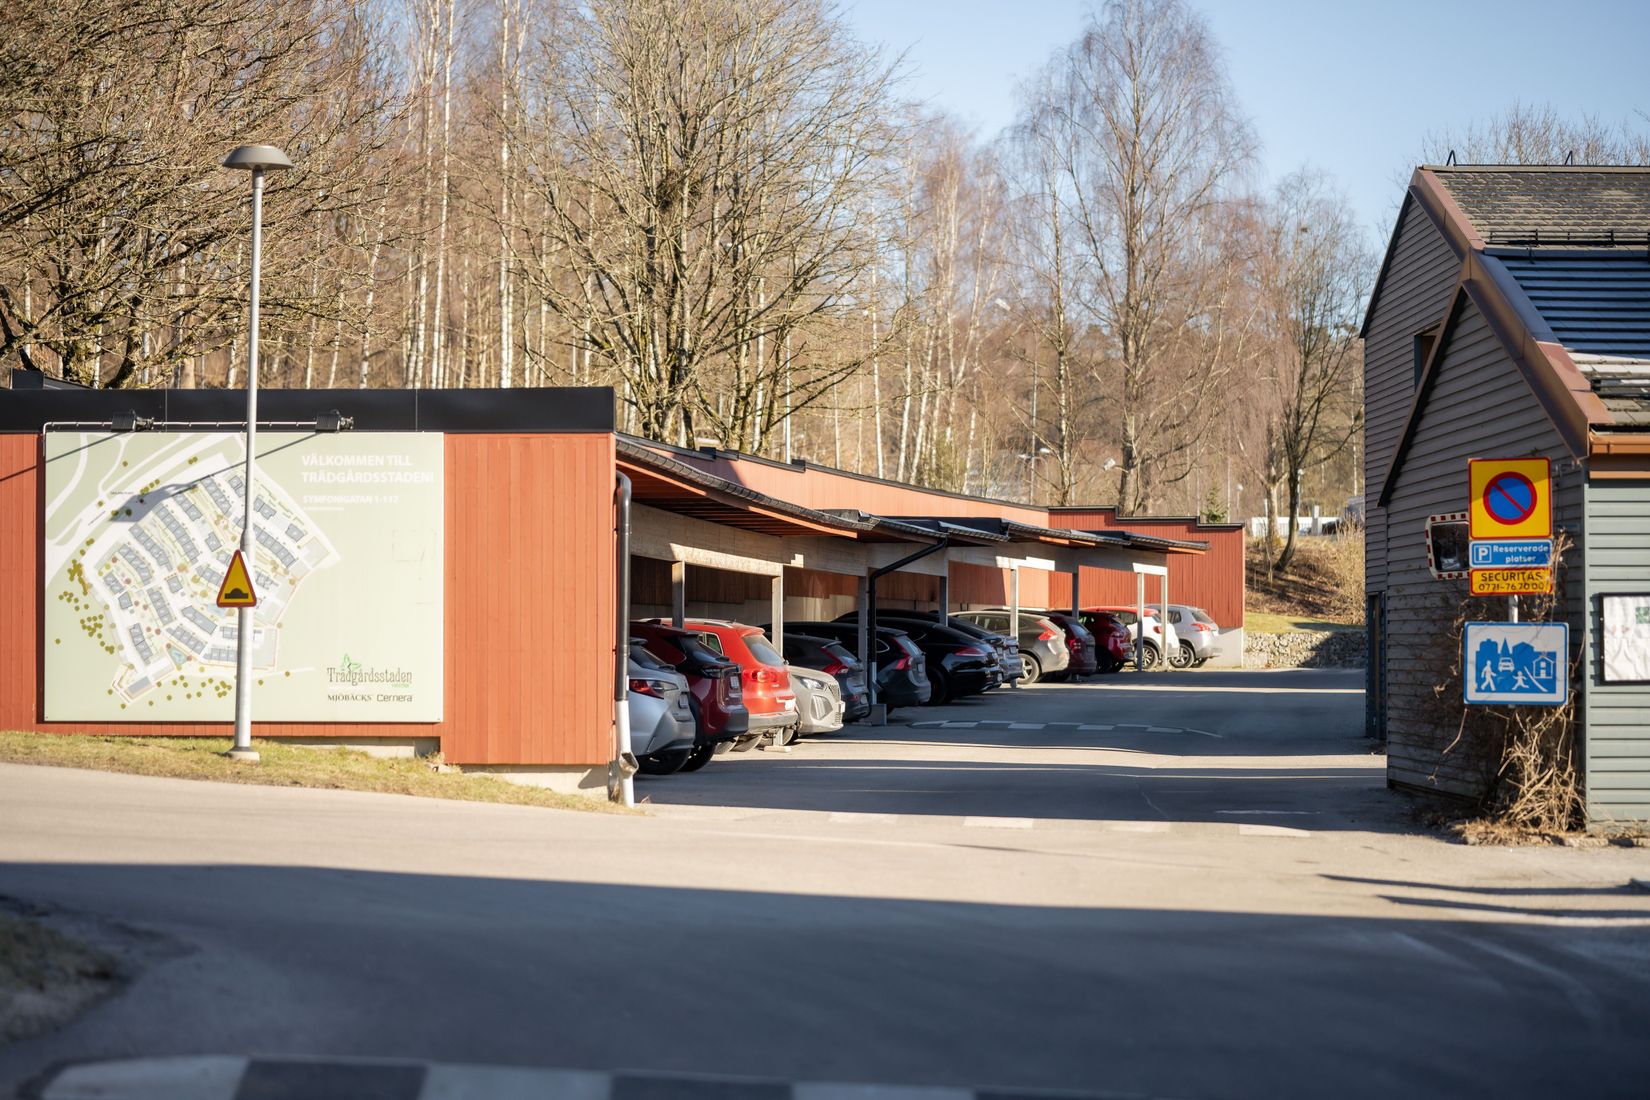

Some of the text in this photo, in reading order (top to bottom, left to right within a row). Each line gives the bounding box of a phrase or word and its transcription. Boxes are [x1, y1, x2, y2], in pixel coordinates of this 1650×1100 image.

[302, 452, 413, 466] VÄLKOMMEN TILL
[1493, 544, 1548, 552] Reserverade
[1478, 548, 1488, 560] P
[1506, 556, 1536, 564] platser
[1481, 572, 1542, 582] SECURITAS
[326, 667, 413, 686] Trädgårdsstaden
[327, 693, 413, 702] MJÖBÄCKS Cernera
